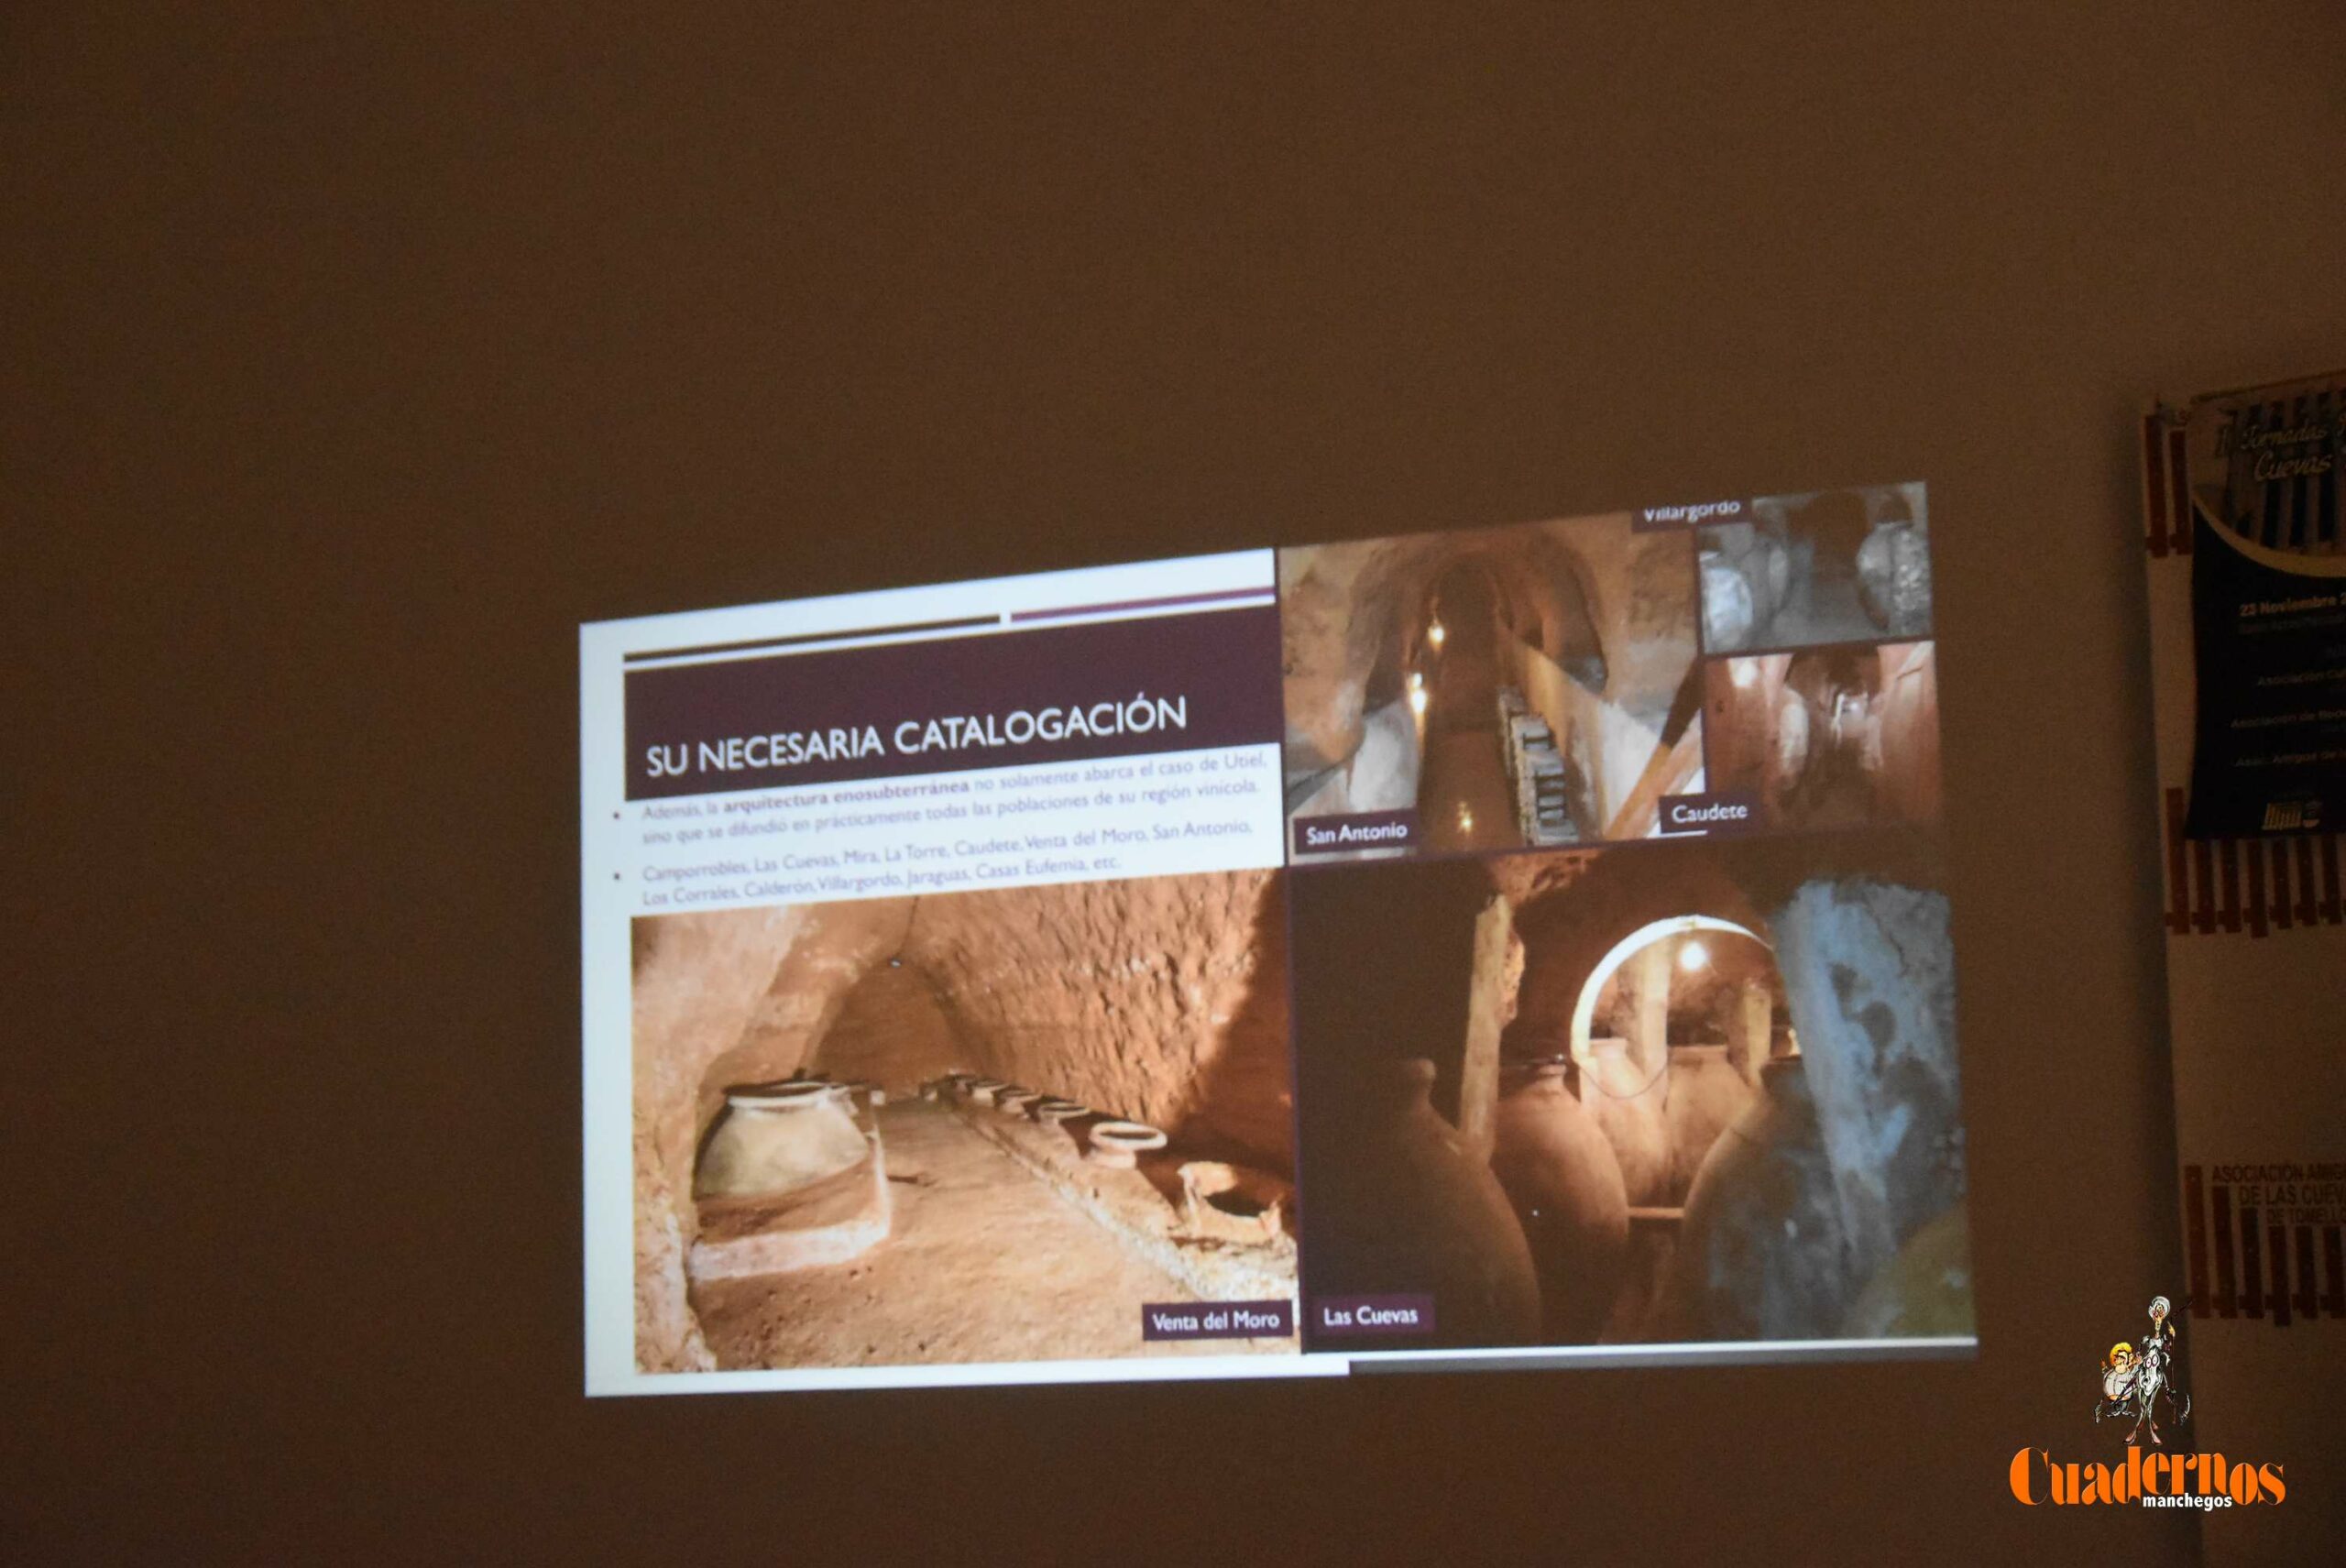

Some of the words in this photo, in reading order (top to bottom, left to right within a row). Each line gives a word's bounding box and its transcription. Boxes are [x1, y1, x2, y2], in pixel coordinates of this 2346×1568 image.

[2253, 450, 2335, 483] Cuevas
[2260, 596, 2338, 615] Noviembre
[646, 743, 688, 778] SU
[698, 725, 885, 773] NECESARIA
[893, 689, 1188, 754] CATALOGACIÓN
[707, 802, 718, 815] la
[724, 794, 828, 815] arquitectura
[834, 781, 970, 804] enosubterránea
[974, 778, 994, 791] no
[1000, 771, 1079, 789] solamente
[1084, 764, 1135, 783] abarca
[1140, 761, 1154, 777] el
[1158, 762, 1193, 776] caso
[1199, 755, 1219, 772] de
[643, 828, 672, 844] sino
[676, 827, 703, 846] que
[707, 826, 723, 839] se
[792, 819, 810, 833] en
[925, 801, 967, 822] todas
[972, 799, 992, 817] las
[997, 794, 1090, 818] poblaciones
[1093, 788, 1114, 806] de
[1118, 790, 1136, 805] su
[1141, 782, 1191, 806] región
[1671, 802, 1749, 824] Caudete
[754, 855, 778, 872] Las
[782, 851, 841, 871] Cuevas,
[884, 844, 902, 863] La
[904, 839, 951, 861] Torre,
[1024, 833, 1069, 850] Venta
[1073, 828, 1097, 847] del
[1102, 827, 1149, 846] Moro,
[1153, 821, 1180, 840] San
[1306, 826, 1336, 845] San
[1338, 821, 1409, 843] Antonio
[643, 889, 669, 906] Los
[976, 861, 1020, 880] Casas
[2239, 1185, 2261, 1206] DE
[2265, 1184, 2297, 1206] LAS
[1152, 1313, 1199, 1331] Venta
[1203, 1310, 1229, 1330] del
[1233, 1310, 1280, 1329] Moro
[1322, 1308, 1352, 1325] Las
[1355, 1305, 1419, 1325] Cuevas
